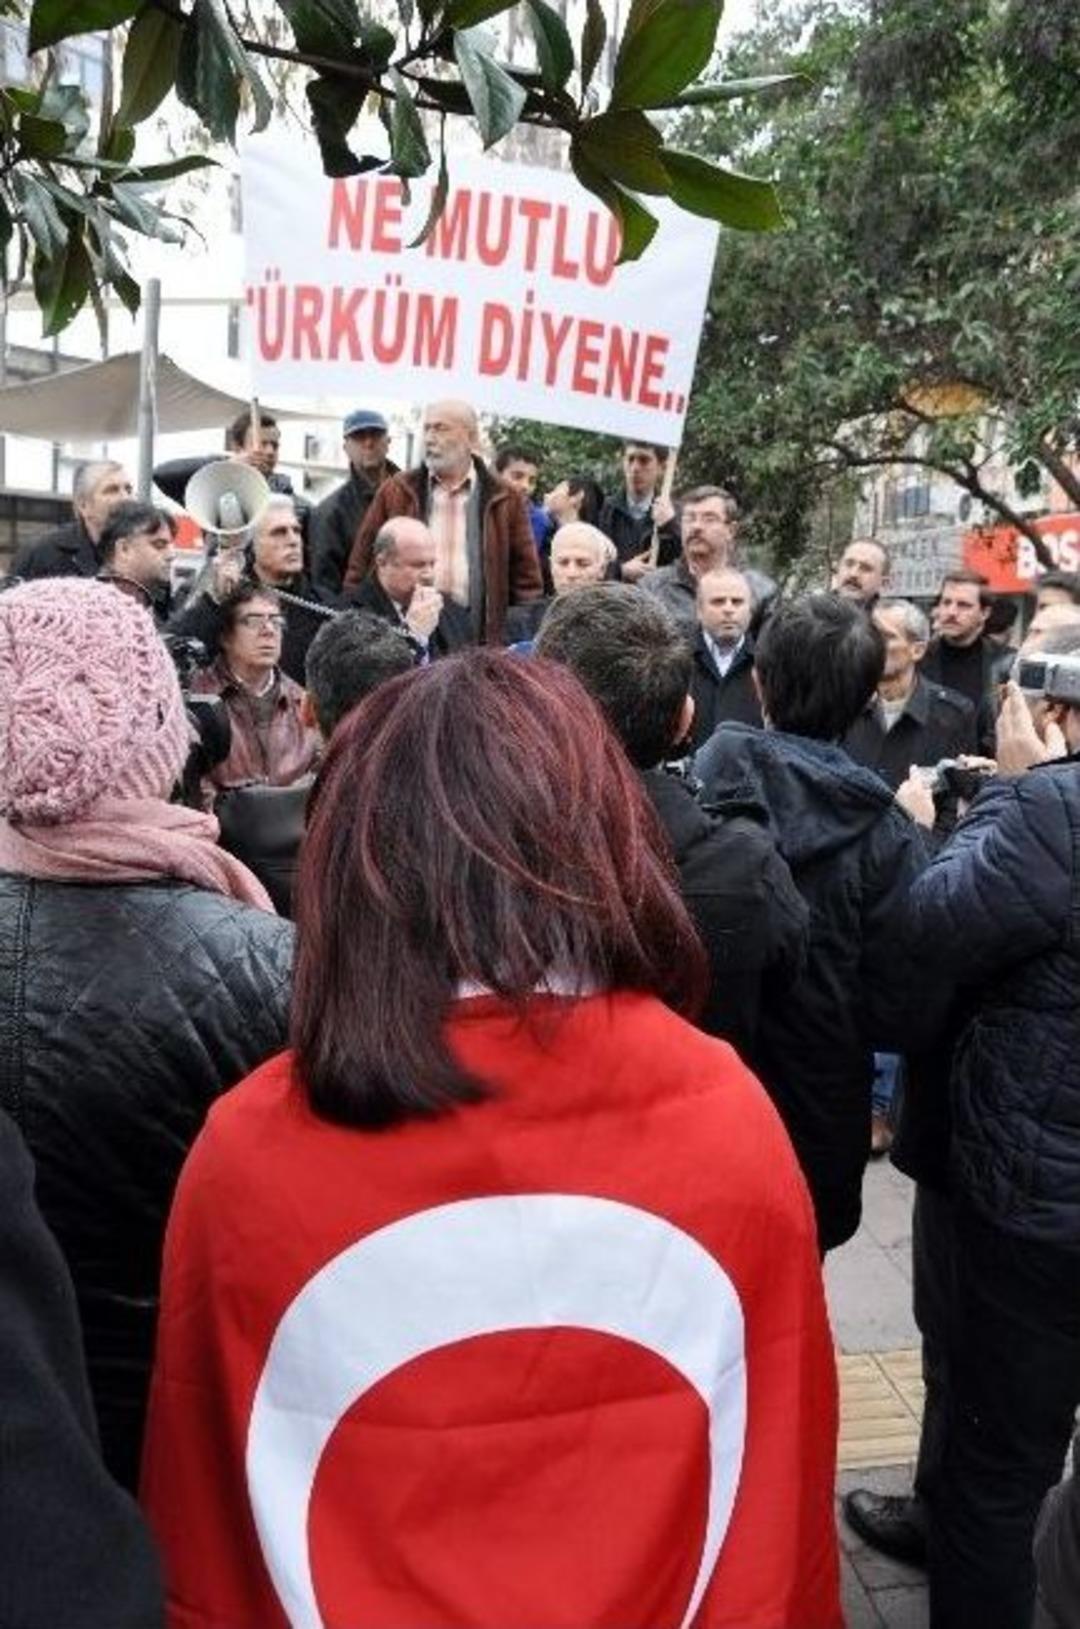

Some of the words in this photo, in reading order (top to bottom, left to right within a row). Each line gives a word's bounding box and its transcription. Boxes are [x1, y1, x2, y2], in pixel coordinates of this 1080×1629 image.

[328, 178, 402, 254] NE
[425, 188, 620, 287] MUTLU
[246, 268, 458, 370] ÜRKÜM
